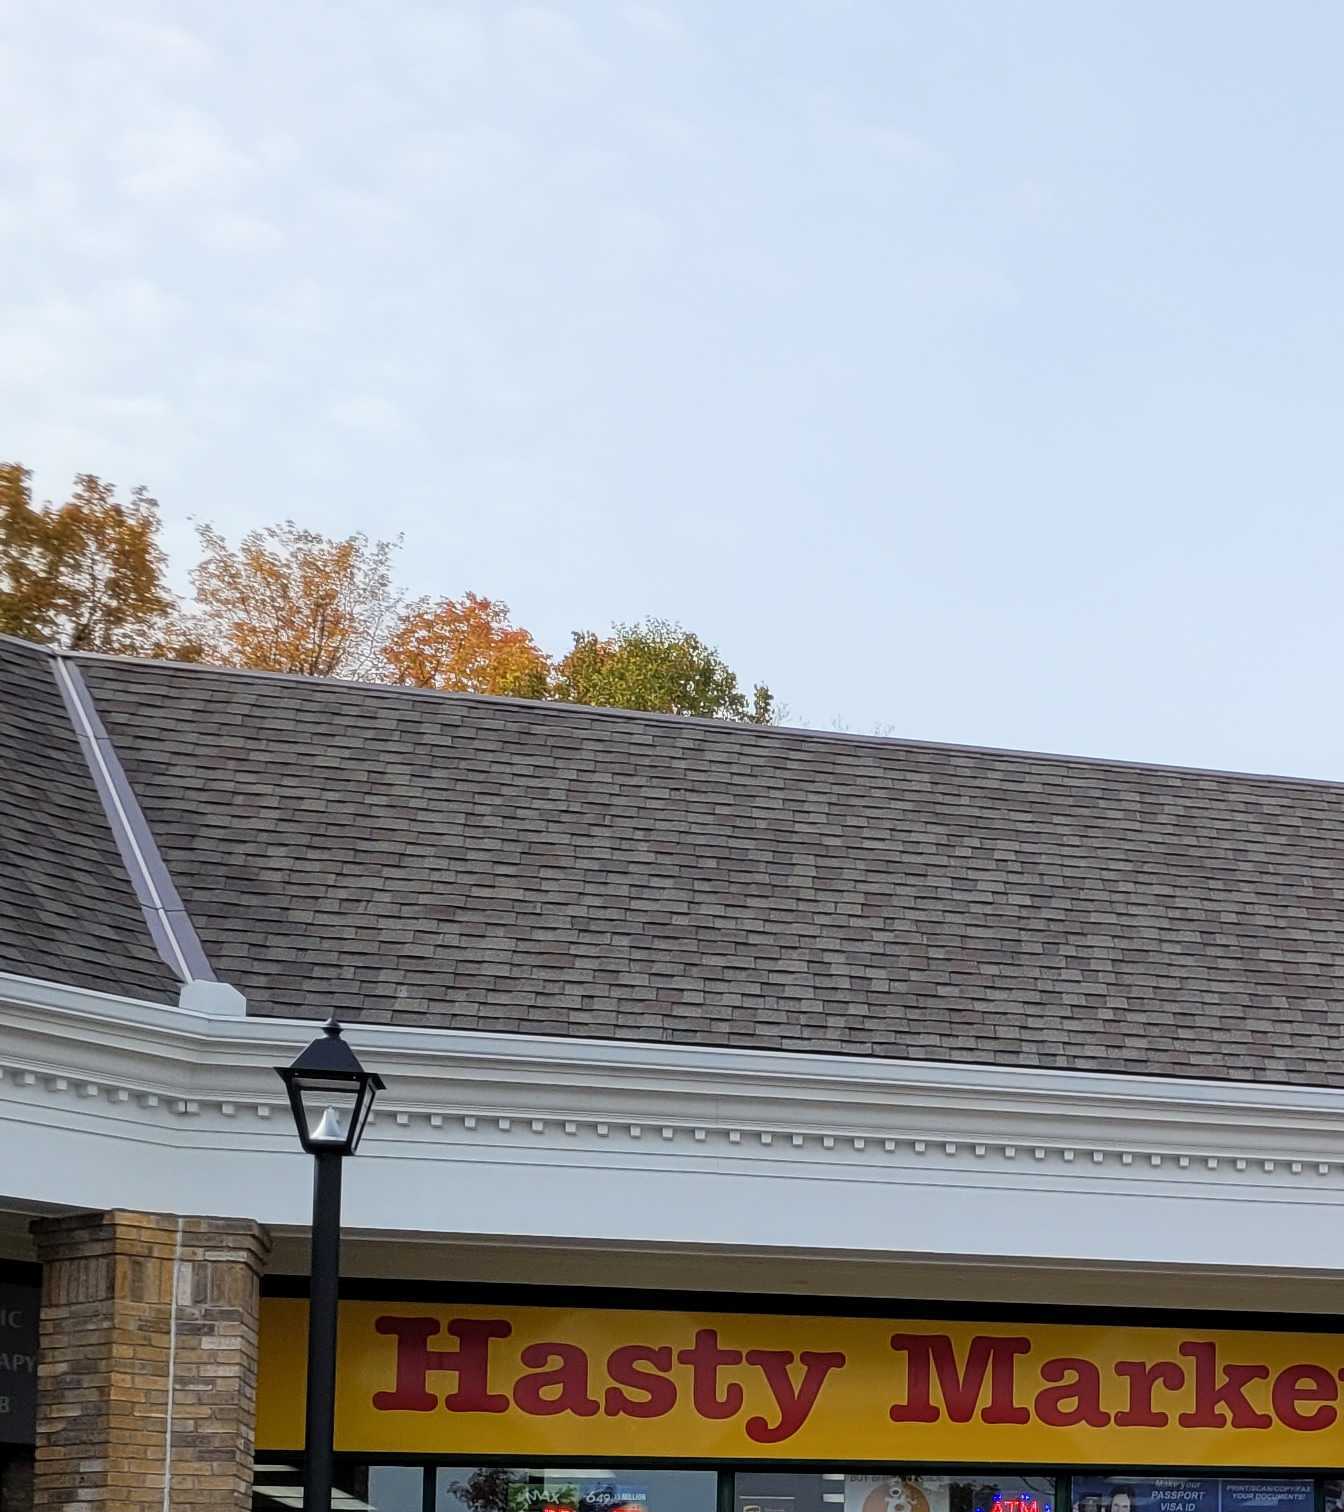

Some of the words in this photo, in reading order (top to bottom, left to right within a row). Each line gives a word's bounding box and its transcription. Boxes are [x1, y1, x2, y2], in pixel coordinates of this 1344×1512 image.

[372, 1315, 847, 1444] Hasty
[1151, 1490, 1206, 1501] PASSPORT
[1160, 1502, 1184, 1512] VISA
